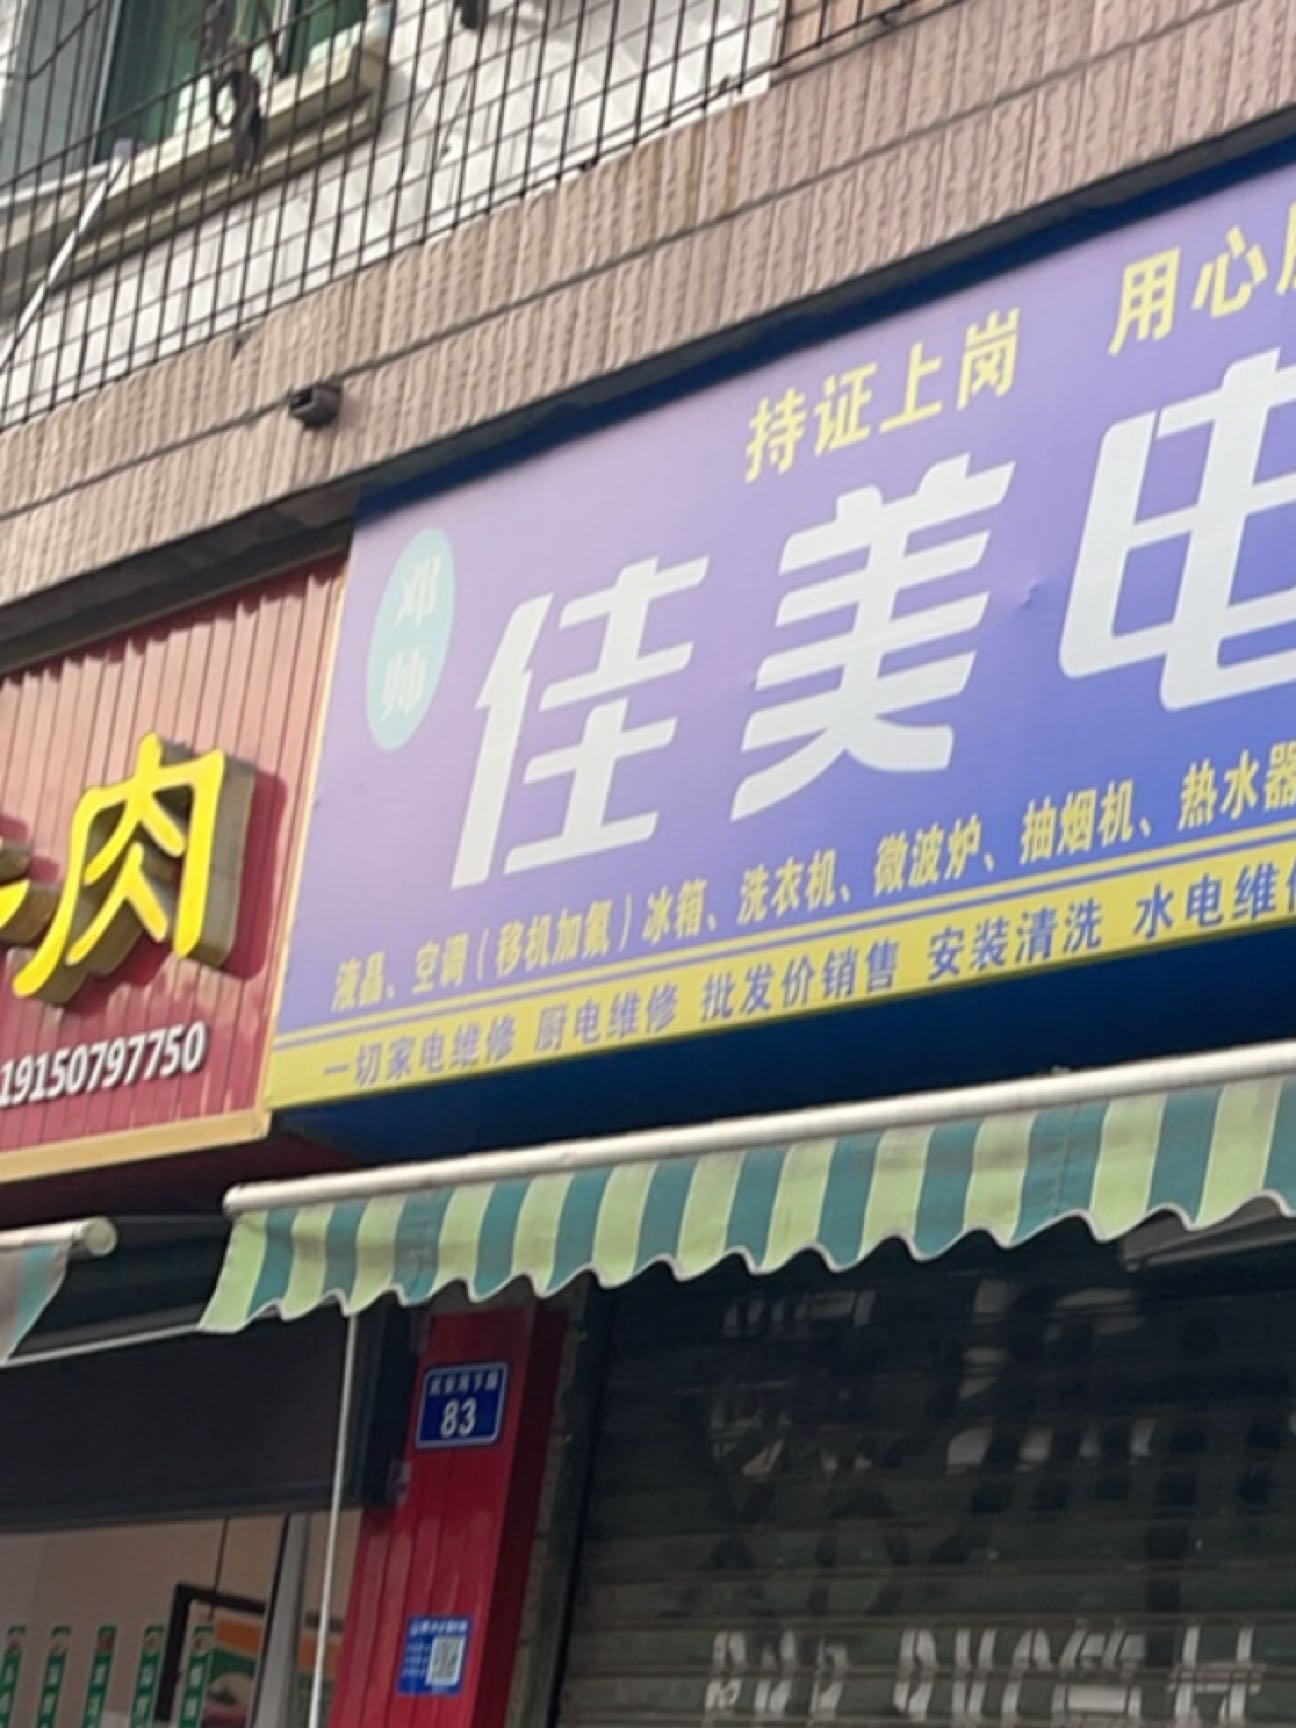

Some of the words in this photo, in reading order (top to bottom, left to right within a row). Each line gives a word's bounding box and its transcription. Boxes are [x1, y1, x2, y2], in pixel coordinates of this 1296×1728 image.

[744, 306, 1021, 482] 持证上岗
[0, 732, 226, 997] 肉
[0, 1020, 209, 1108] 19150797750
[322, 1015, 517, 1089] 一切家电维修
[532, 978, 680, 1052] 厨电维修
[699, 937, 901, 1020] 批发价销售
[926, 896, 1104, 982] 安装清洗
[440, 1397, 477, 1438] 83
